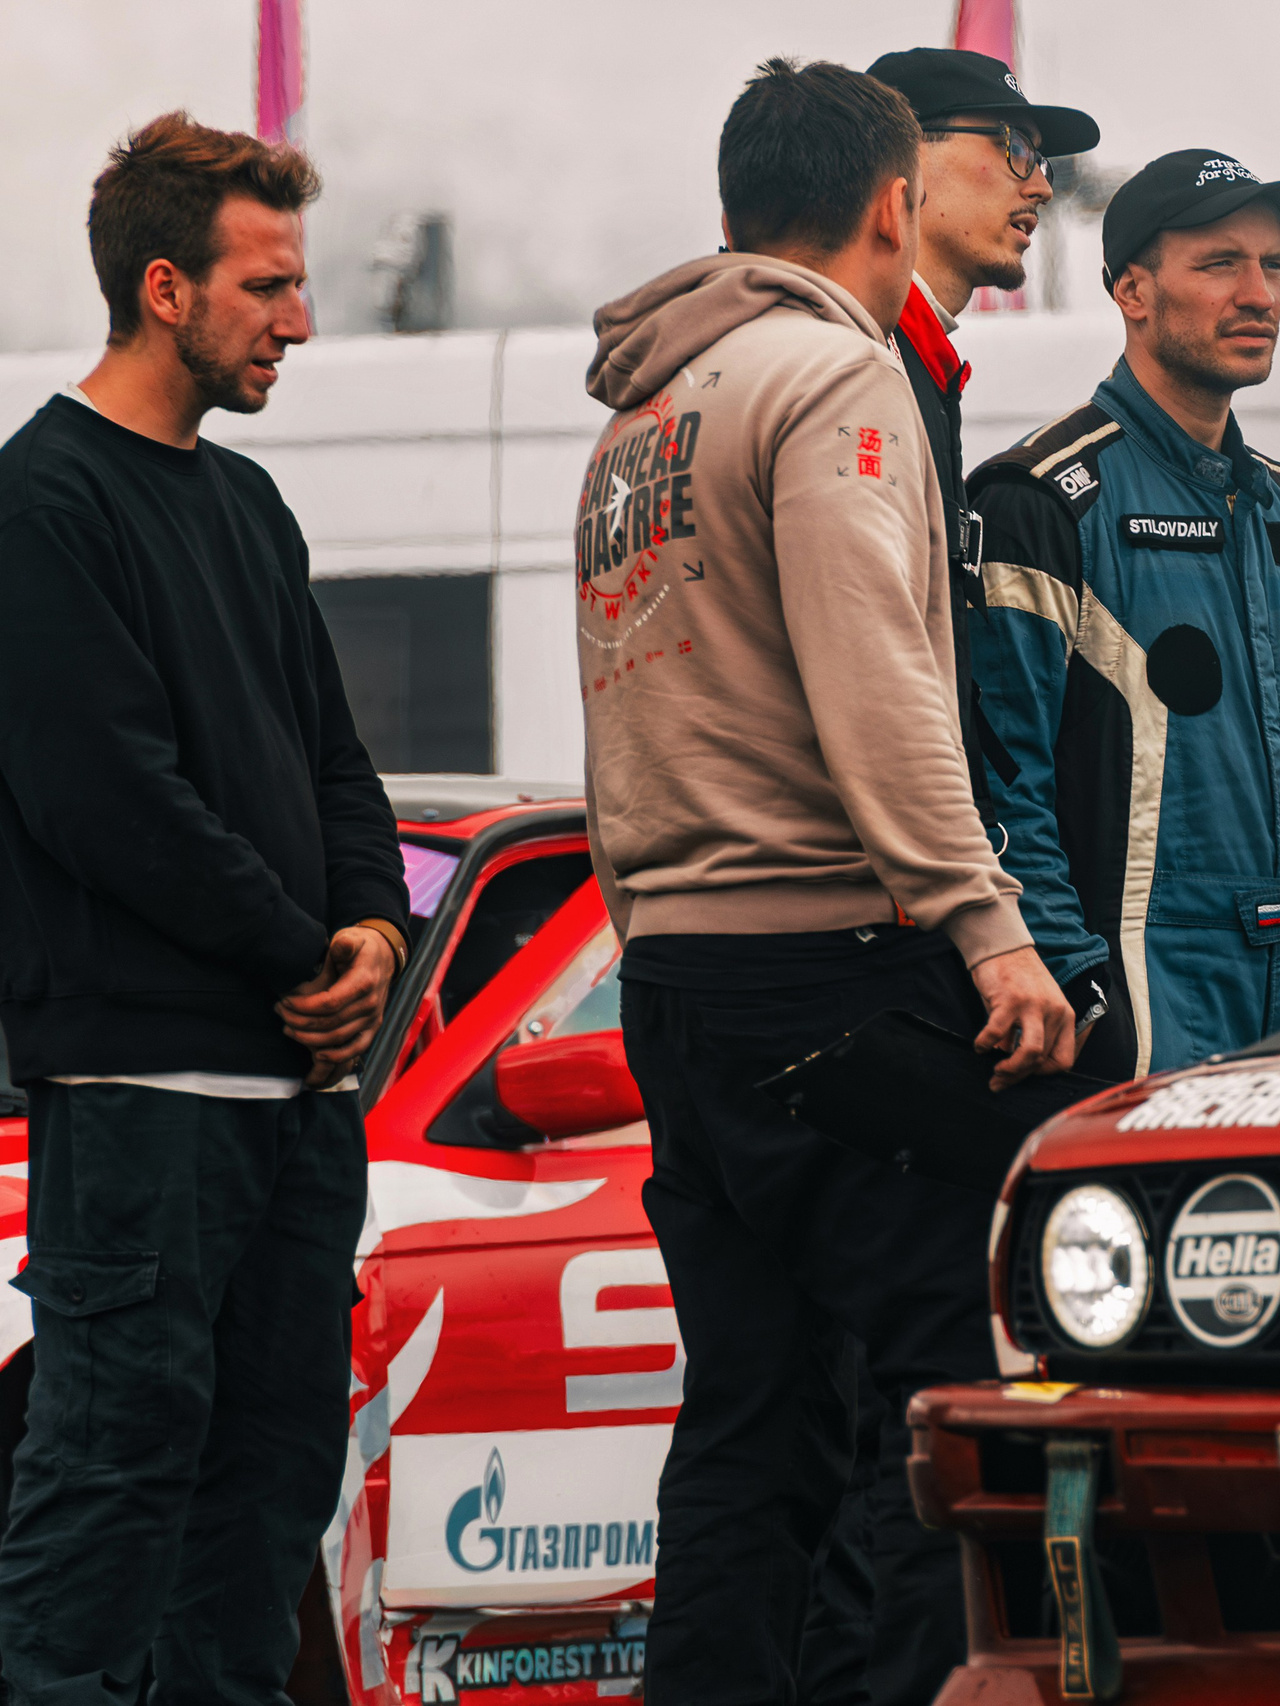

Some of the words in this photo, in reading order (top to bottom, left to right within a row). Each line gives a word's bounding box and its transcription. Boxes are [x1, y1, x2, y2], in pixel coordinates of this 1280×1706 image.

[1195, 169, 1221, 186] for
[1060, 466, 1092, 495] OMP
[1129, 519, 1218, 537] STILOVDAILY
[1177, 1233, 1280, 1277] Hella
[506, 1519, 655, 1572] ГАЗПРОМ
[456, 1643, 597, 1686] KINFOREST
